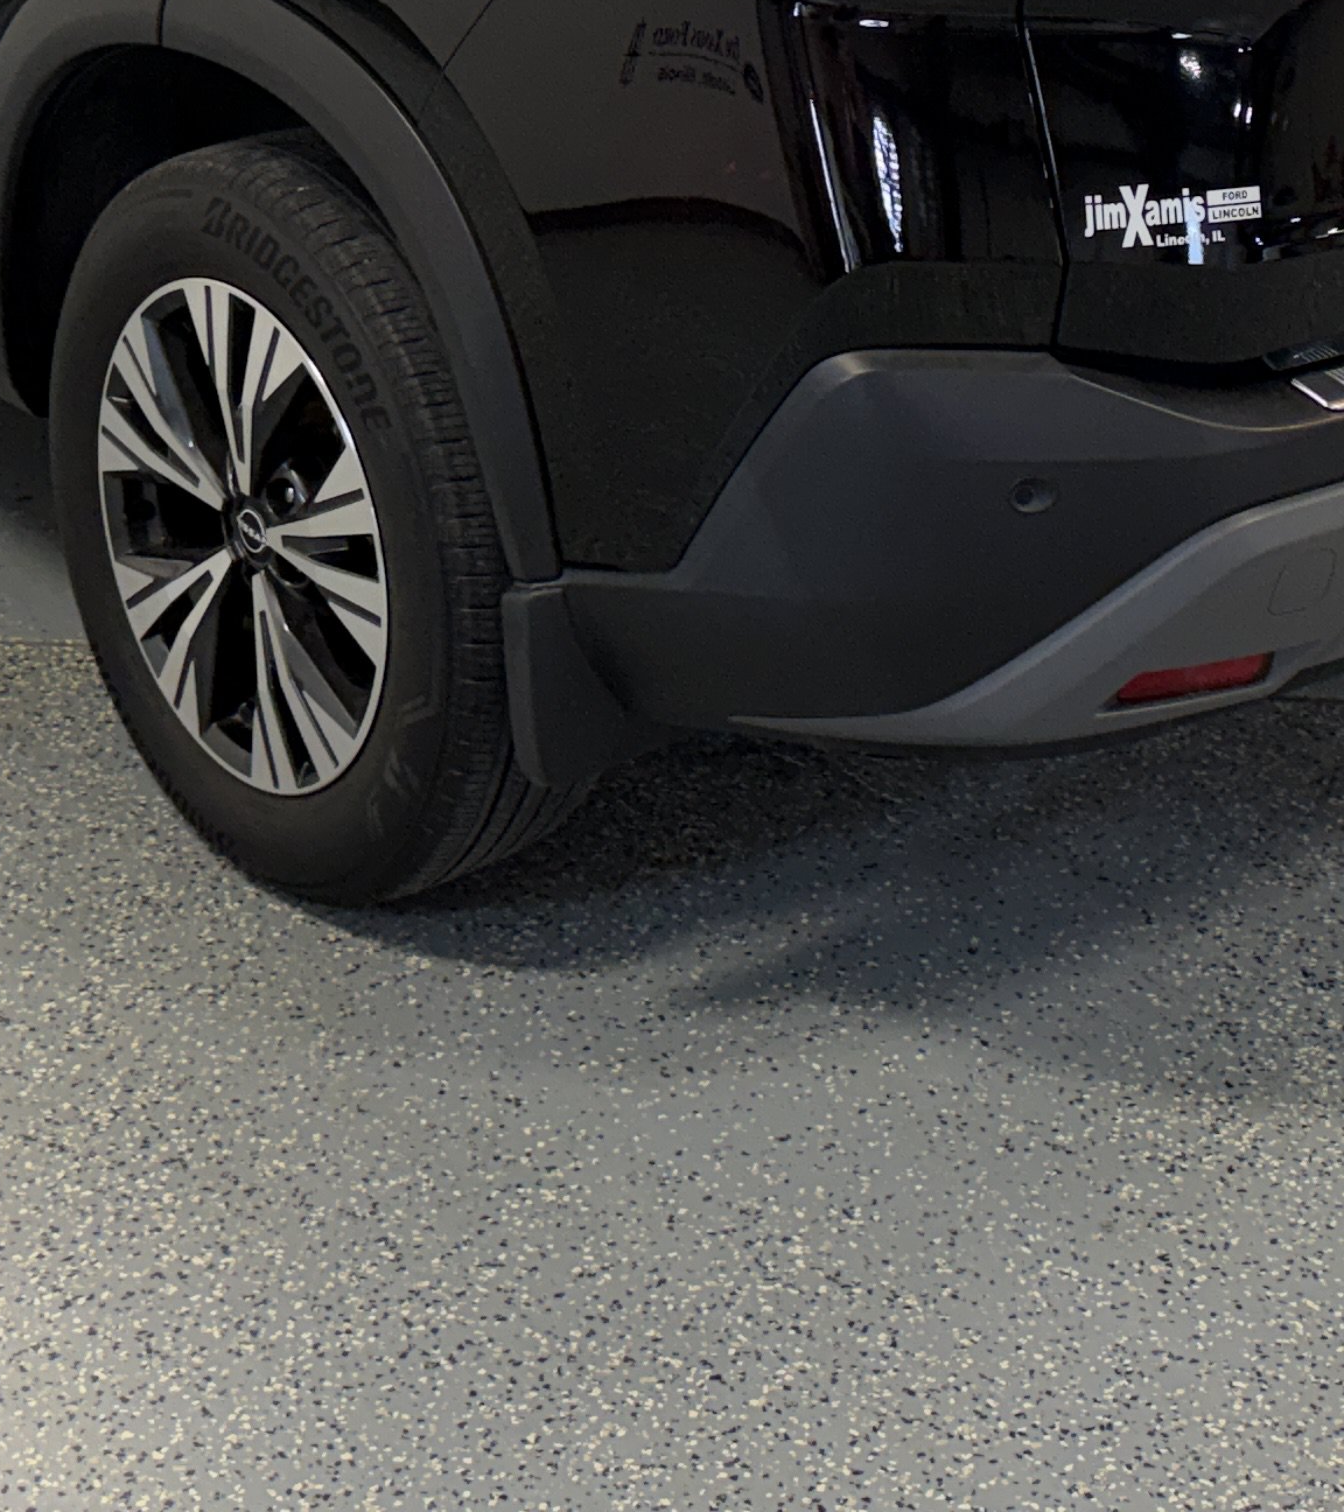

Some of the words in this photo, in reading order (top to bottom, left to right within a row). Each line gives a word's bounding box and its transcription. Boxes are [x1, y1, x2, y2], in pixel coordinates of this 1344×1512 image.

[1221, 190, 1248, 201] FORD
[1212, 206, 1260, 220] LINCOLN
[1212, 230, 1226, 243] IL
[200, 196, 393, 432] BRIDGESTONE
